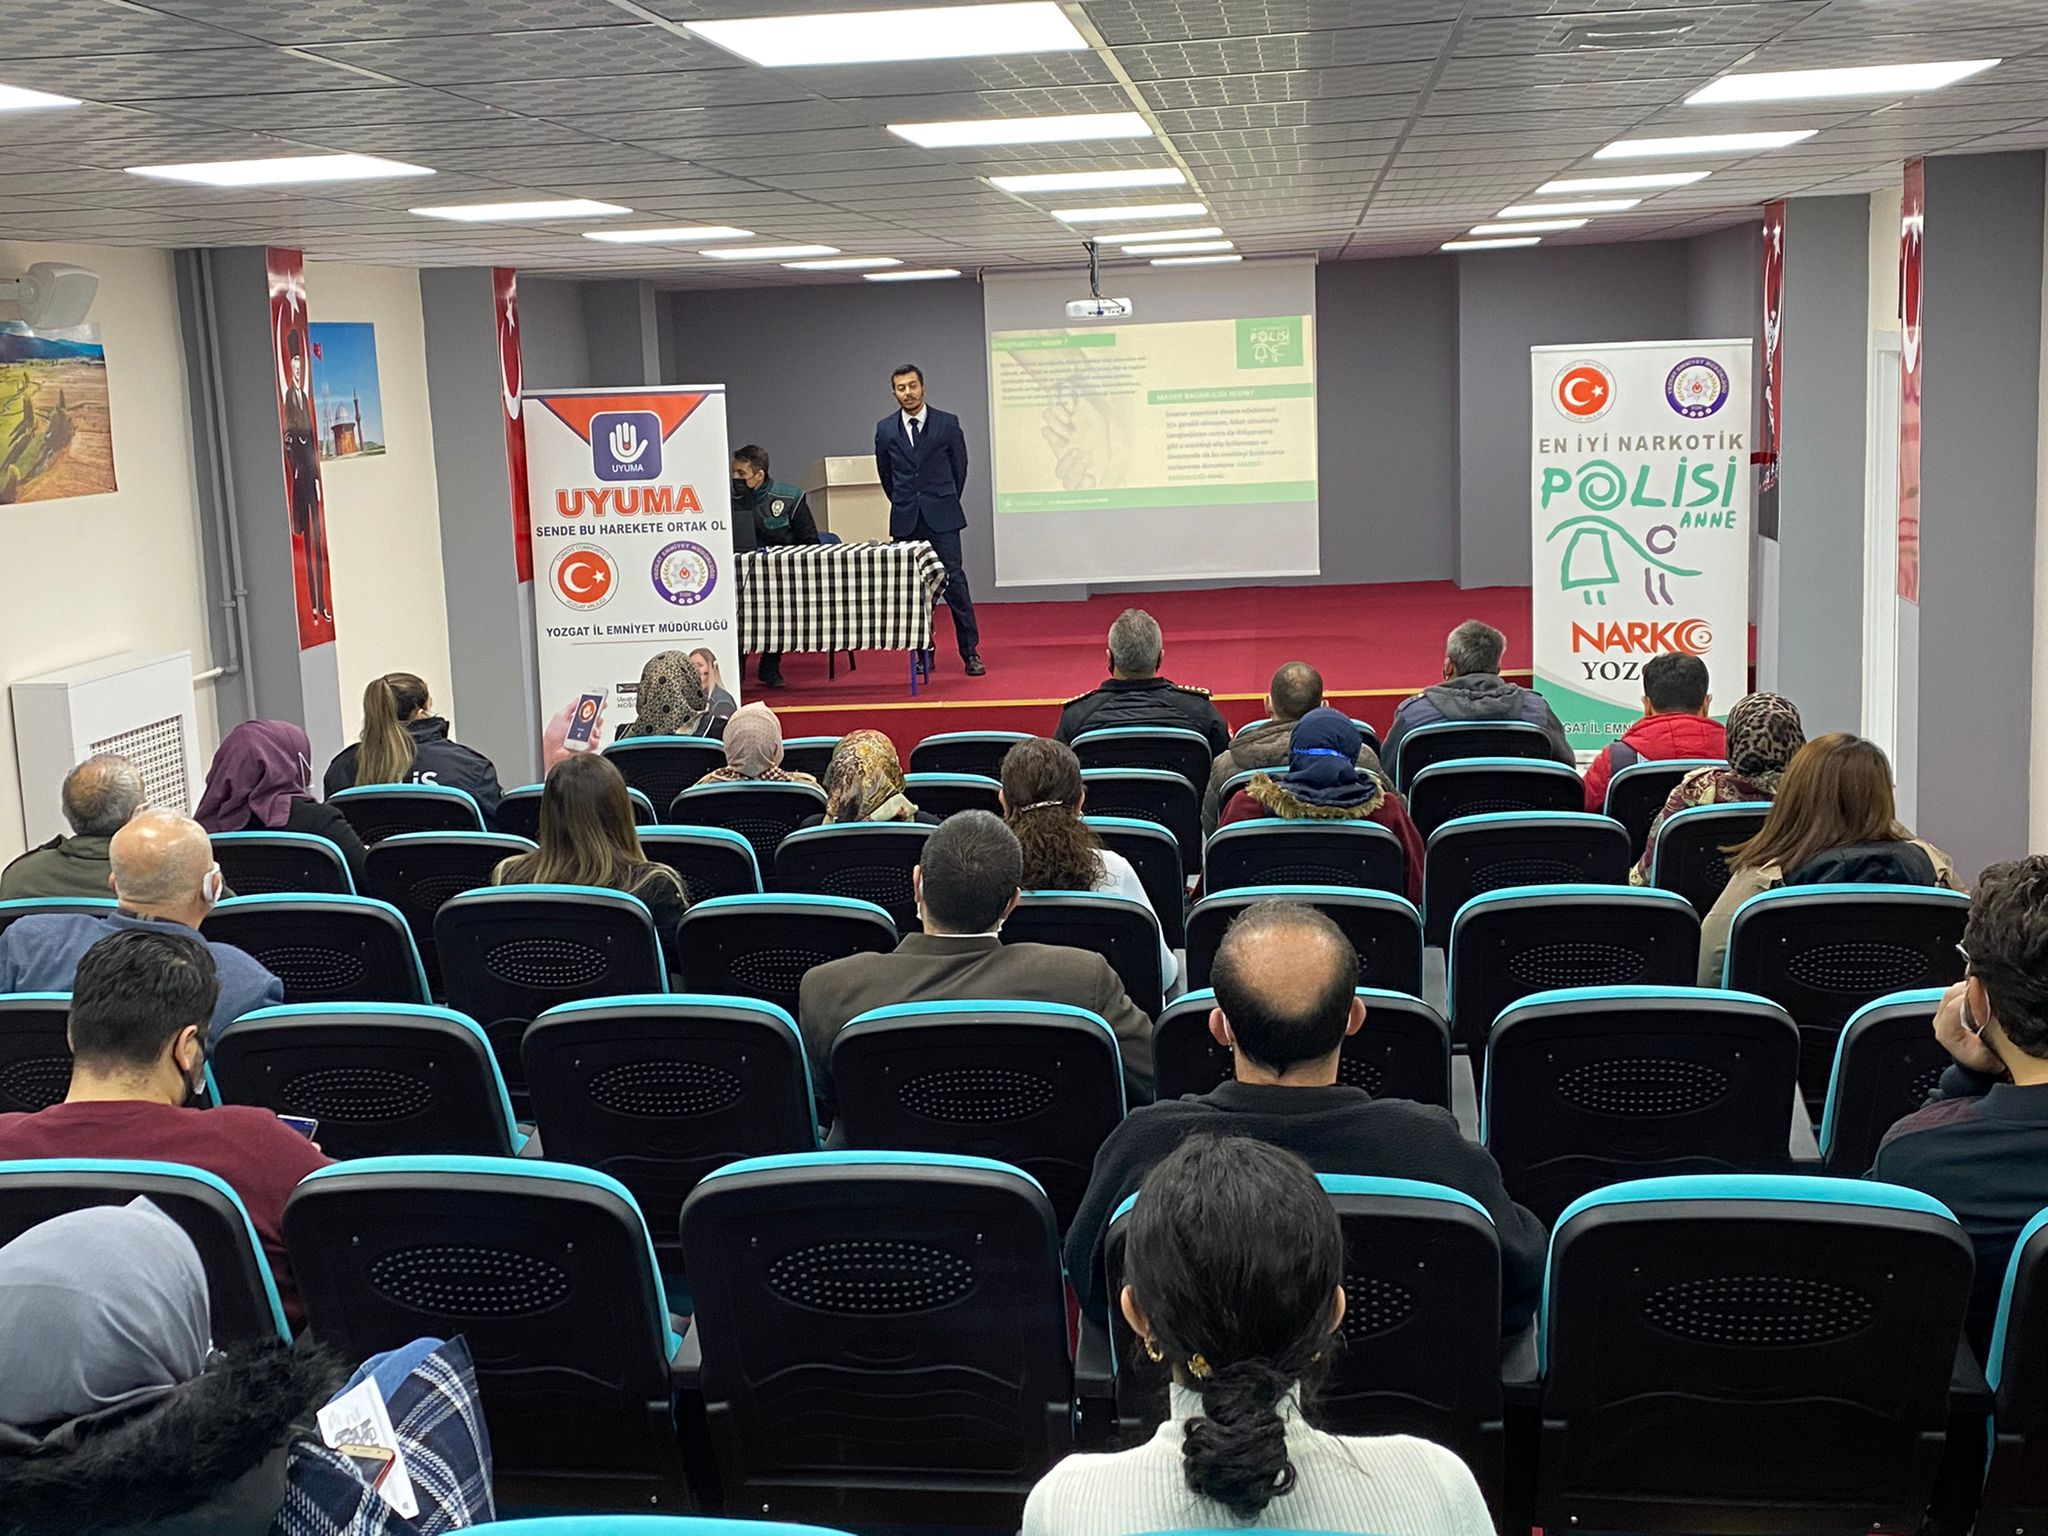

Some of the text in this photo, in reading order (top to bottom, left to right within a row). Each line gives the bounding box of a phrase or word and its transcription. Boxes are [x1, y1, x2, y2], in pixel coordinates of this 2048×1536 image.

[1539, 430, 1744, 453] EN İYİ NARKOTİK
[612, 463, 644, 473] UYUMA
[1541, 455, 1737, 512] POLİSİ
[556, 485, 703, 518] UYUMA
[536, 519, 727, 537] SENDE BU HAREKETE ORTAK OL
[1680, 510, 1736, 529] ANNE
[546, 619, 728, 638] YOZGAT İL EMNİYET MÜDÜRLÜĞÜ
[1581, 661, 1641, 681] YOZ
[1563, 722, 1587, 734] GAT
[1590, 720, 1601, 734] İL
